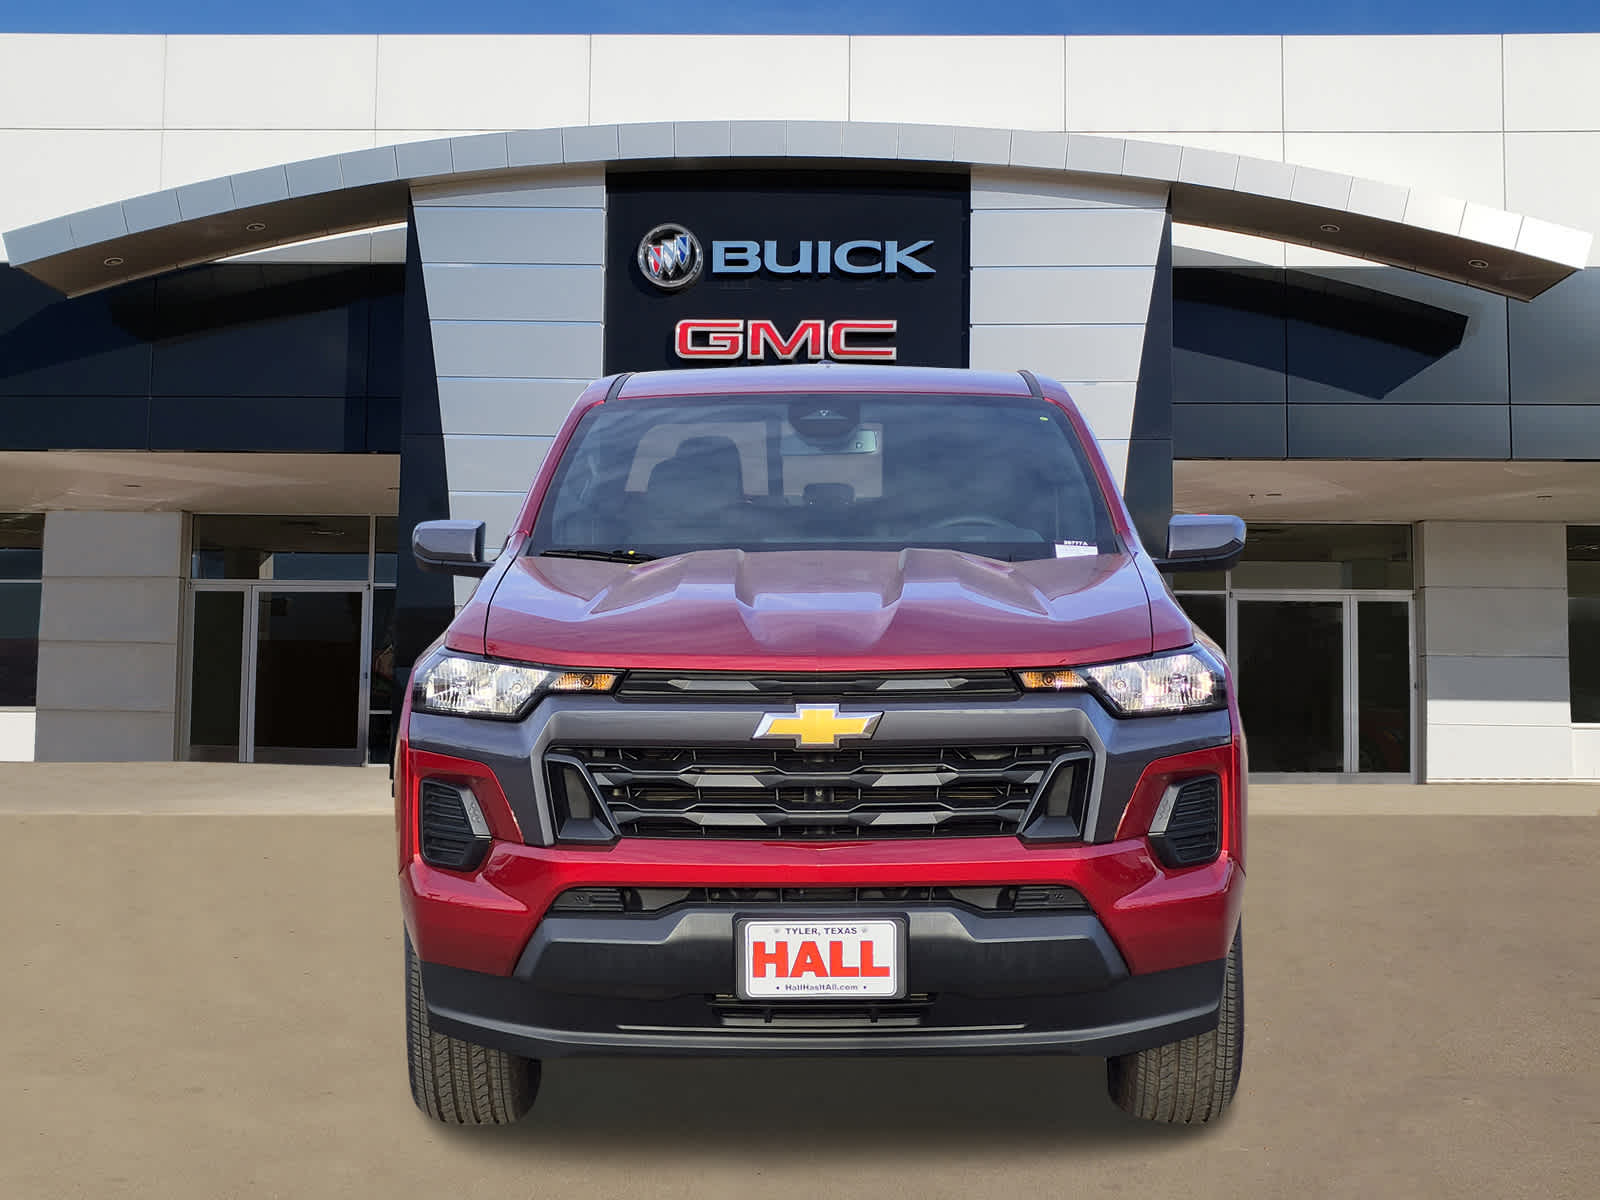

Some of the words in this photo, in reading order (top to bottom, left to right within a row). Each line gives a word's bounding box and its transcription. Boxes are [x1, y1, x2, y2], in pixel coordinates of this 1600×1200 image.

[712, 240, 937, 273] BUICK
[675, 319, 897, 360] GMC
[785, 927, 821, 936] TYLER,
[824, 927, 857, 935] TEXAS
[753, 940, 890, 978] HALL
[785, 983, 858, 991] HallHasItAll.com
